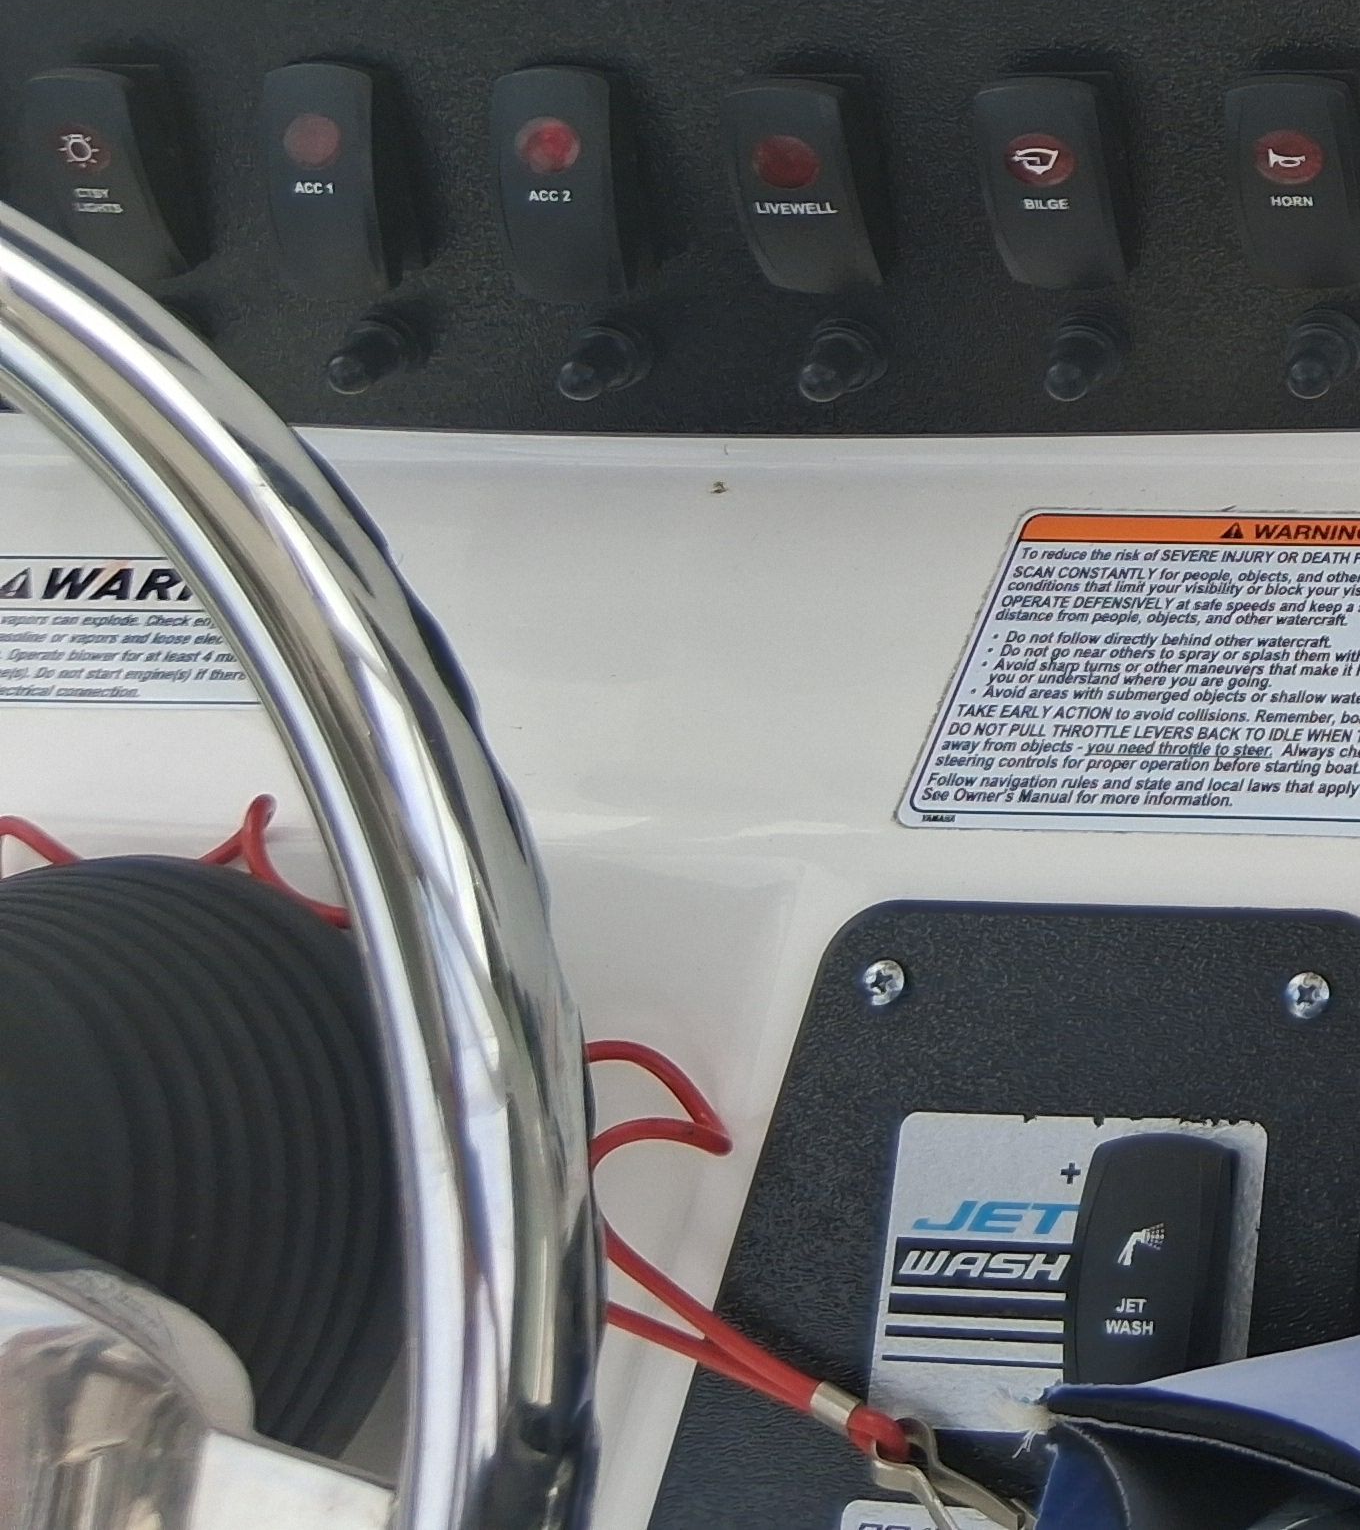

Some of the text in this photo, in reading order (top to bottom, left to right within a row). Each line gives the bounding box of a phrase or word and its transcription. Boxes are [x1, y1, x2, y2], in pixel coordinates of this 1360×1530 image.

[294, 181, 335, 195] ACC 1
[528, 189, 572, 203] ACC 2
[755, 201, 838, 217] LIVEWELL
[1023, 197, 1070, 211] BILGE
[1270, 195, 1315, 208] HORN
[1022, 546, 1038, 559] To
[1041, 546, 1087, 560] reduce
[1090, 547, 1111, 560] the
[1115, 548, 1141, 561] risk
[1143, 548, 1158, 561] of
[1160, 548, 1218, 562] SEVERE
[1221, 549, 1273, 562] INJURY
[1276, 550, 1299, 563] OR
[1302, 550, 1350, 563] DEATH
[1012, 565, 1052, 580] SCAN
[1057, 565, 1156, 579] CONSTANTLY
[1159, 567, 1179, 580] for
[1182, 567, 1232, 583] people,
[1238, 568, 1291, 584] objects,
[1296, 569, 1323, 582] and
[41, 567, 194, 601] WAR
[1007, 578, 1080, 592] conditions
[1084, 579, 1111, 592] that
[1114, 579, 1145, 592] limit
[1147, 582, 1181, 596] your
[1184, 580, 1243, 596] visibility
[1246, 584, 1262, 594] or
[1265, 582, 1304, 595] block
[1306, 585, 1339, 598] your
[1000, 594, 1070, 608] OPERATE
[1072, 595, 1172, 610] DEFENSIVELY
[1176, 597, 1190, 610] at
[1192, 597, 1222, 610] safe
[1226, 598, 1275, 614] speeds
[1279, 598, 1306, 612] and
[1309, 599, 1342, 615] keep
[1345, 602, 1354, 612] a
[144, 614, 192, 627] Check
[151, 633, 192, 645] loose
[161, 652, 202, 663] least
[201, 651, 215, 663] 4
[912, 1199, 1081, 1235] JET
[898, 1249, 1071, 1281] WASH
[1115, 1297, 1147, 1314] JET
[1104, 1319, 1155, 1336] WASH
